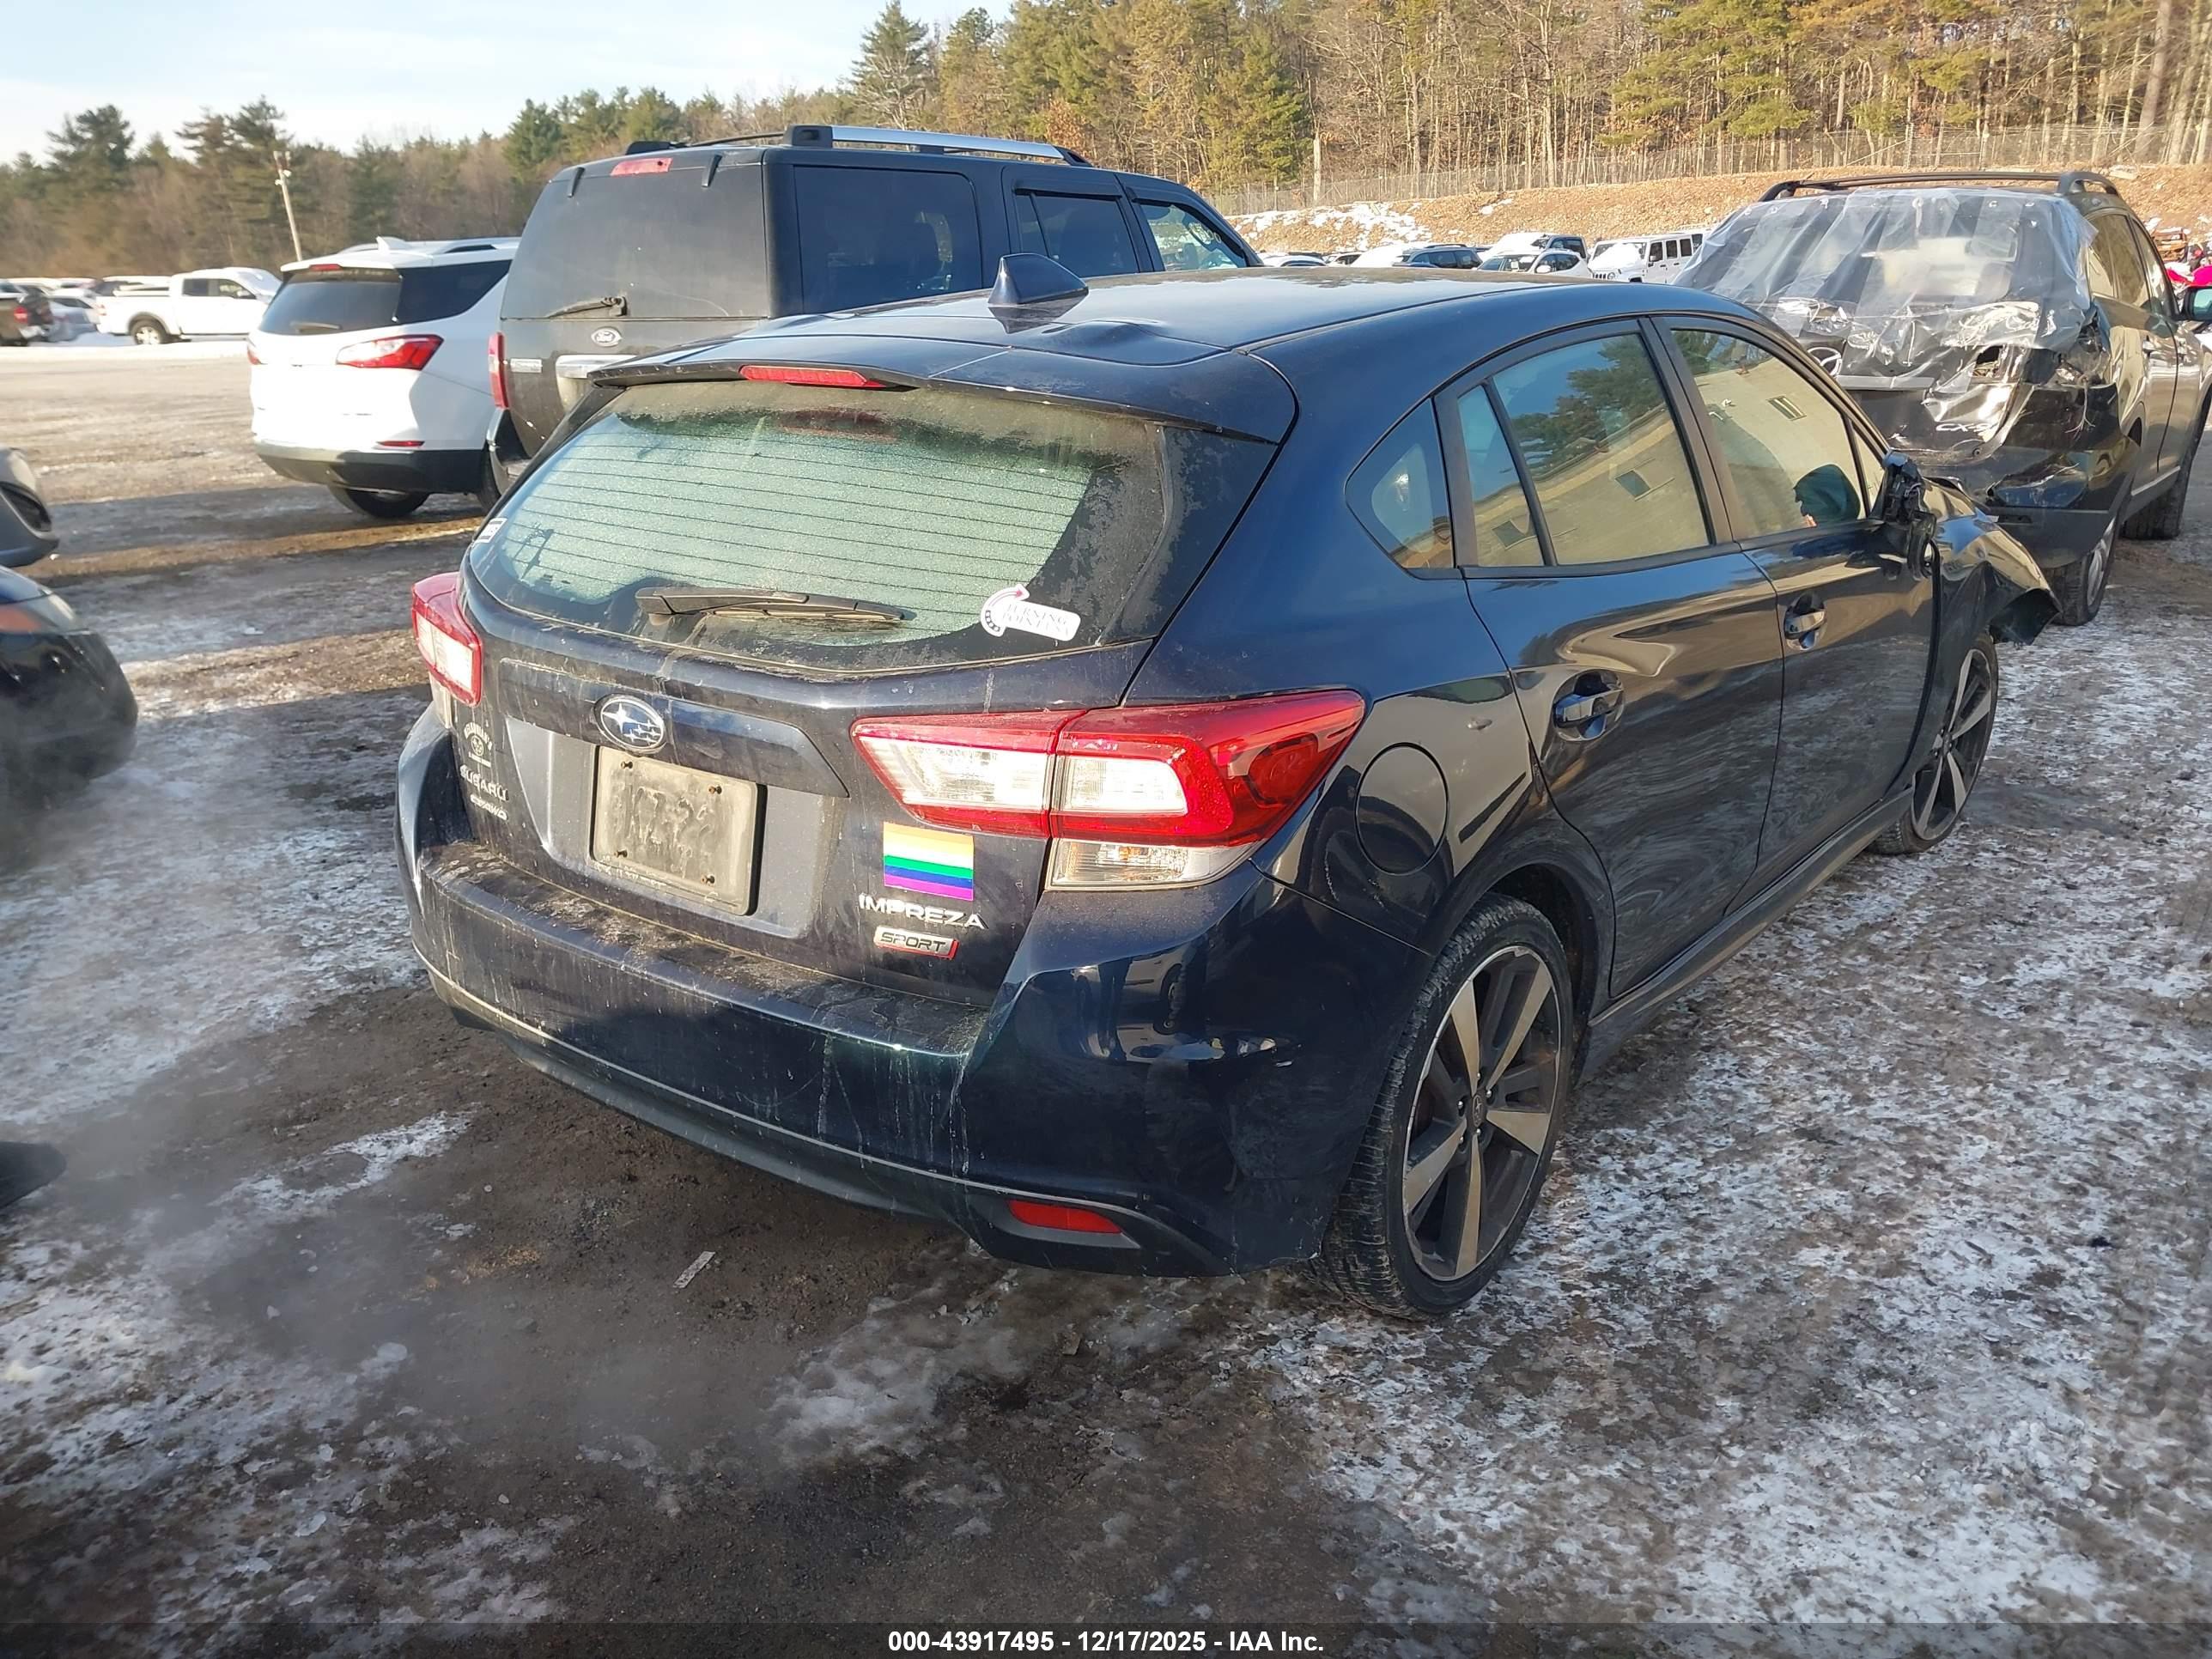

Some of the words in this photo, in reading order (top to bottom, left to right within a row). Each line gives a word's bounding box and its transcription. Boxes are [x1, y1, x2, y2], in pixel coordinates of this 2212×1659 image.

[459, 764, 508, 801] SUBARU
[859, 892, 987, 930] IMPREZA
[880, 931, 946, 952] SPORT
